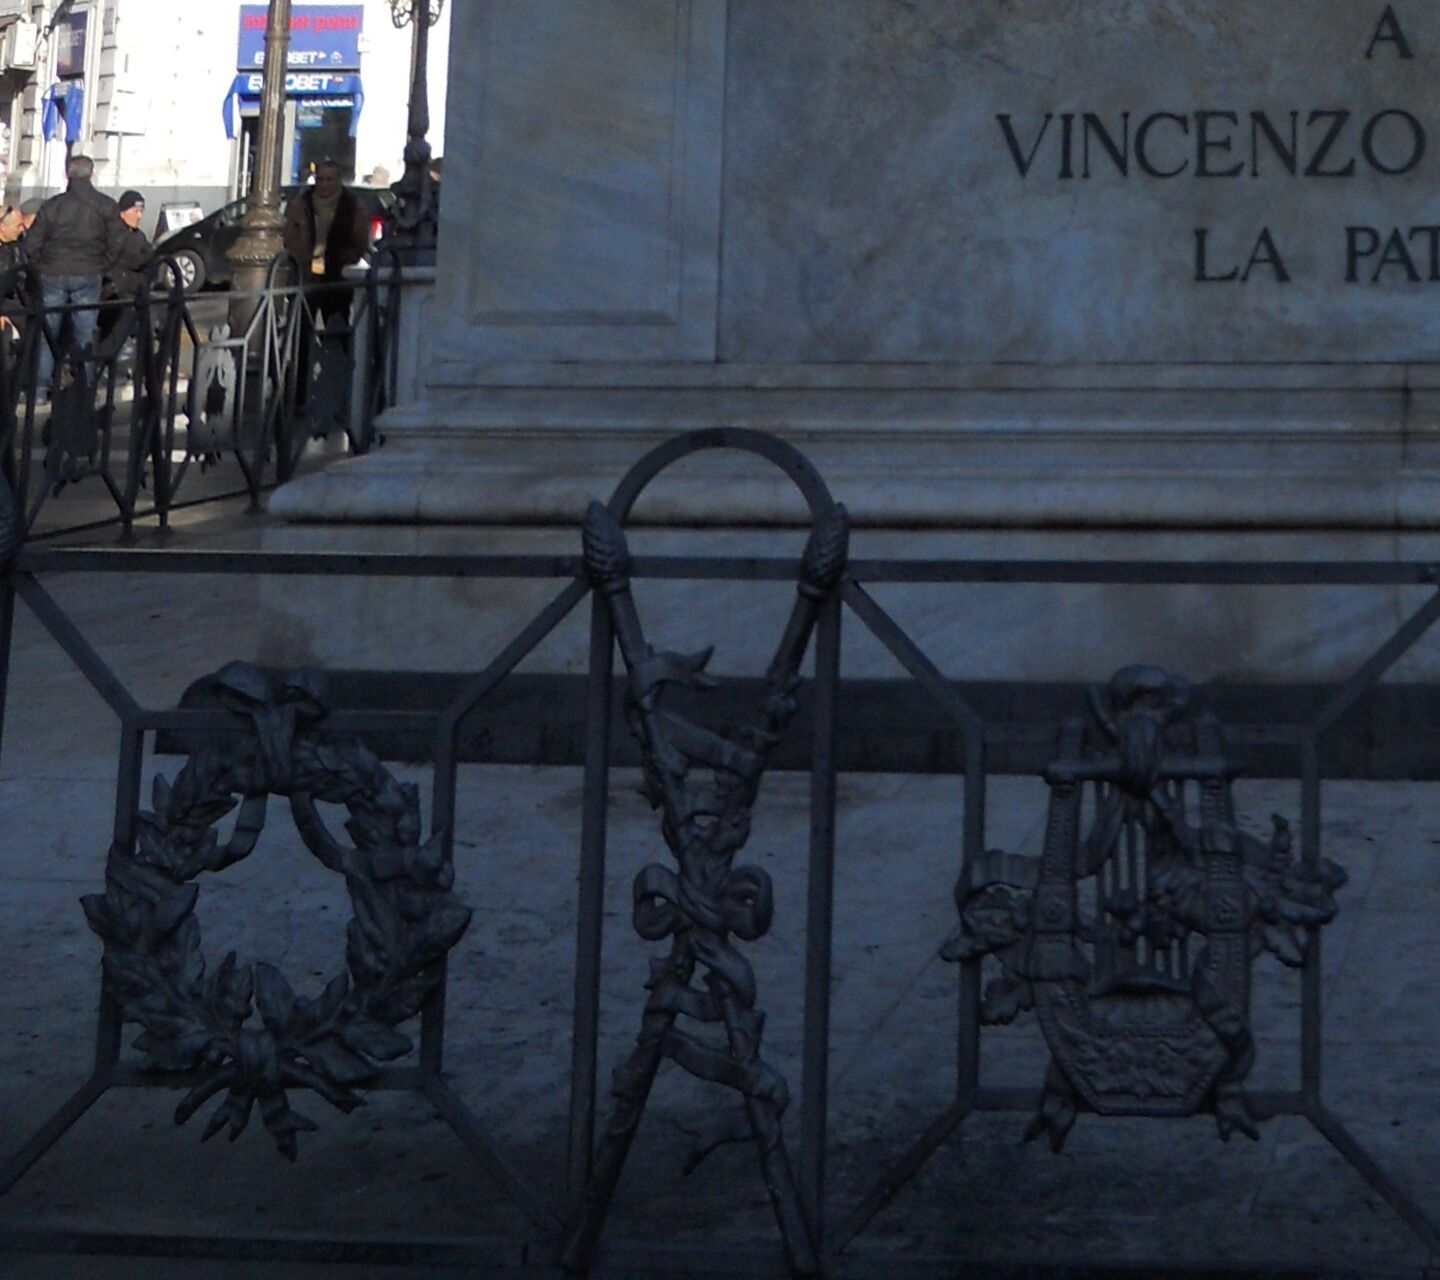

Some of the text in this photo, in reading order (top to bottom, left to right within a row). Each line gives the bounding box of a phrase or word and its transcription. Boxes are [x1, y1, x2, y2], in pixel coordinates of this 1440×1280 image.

[254, 51, 318, 65] EOBET
[1363, 4, 1415, 60] A
[247, 74, 333, 91] EOBET
[995, 108, 1426, 181] VINCENZO
[1193, 227, 1291, 284] LA
